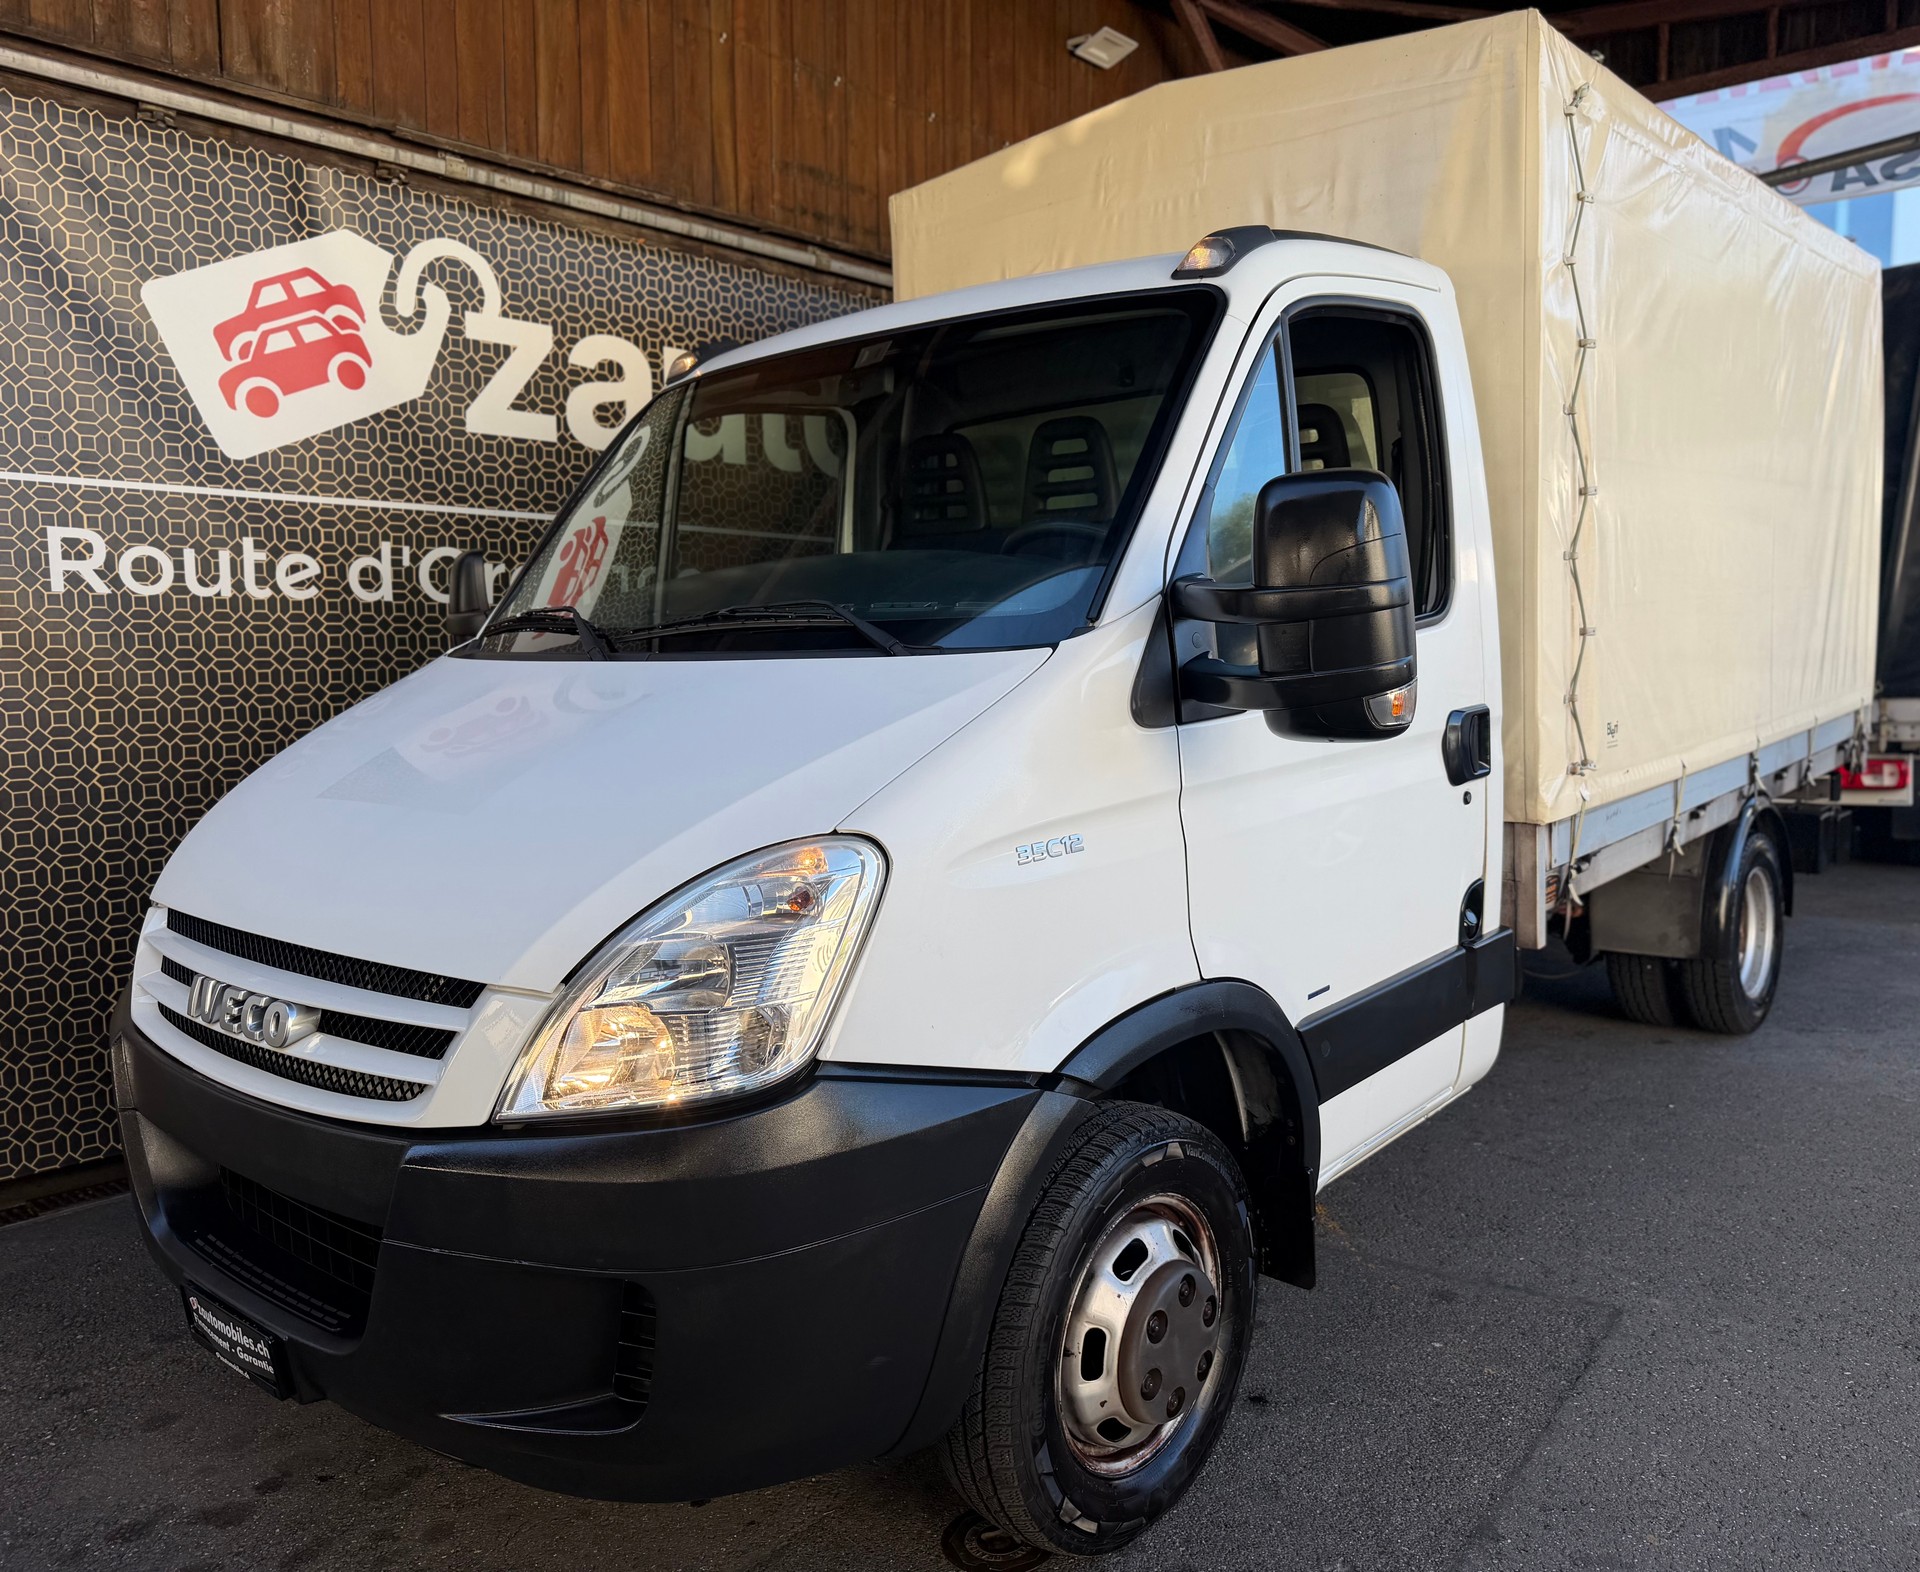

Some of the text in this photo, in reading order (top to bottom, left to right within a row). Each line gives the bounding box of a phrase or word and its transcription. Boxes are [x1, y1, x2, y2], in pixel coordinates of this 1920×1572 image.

[47, 526, 322, 600] Route
[1016, 833, 1084, 866] 35C12
[187, 974, 300, 1048] IVECO
[236, 1346, 275, 1374] Garantie
